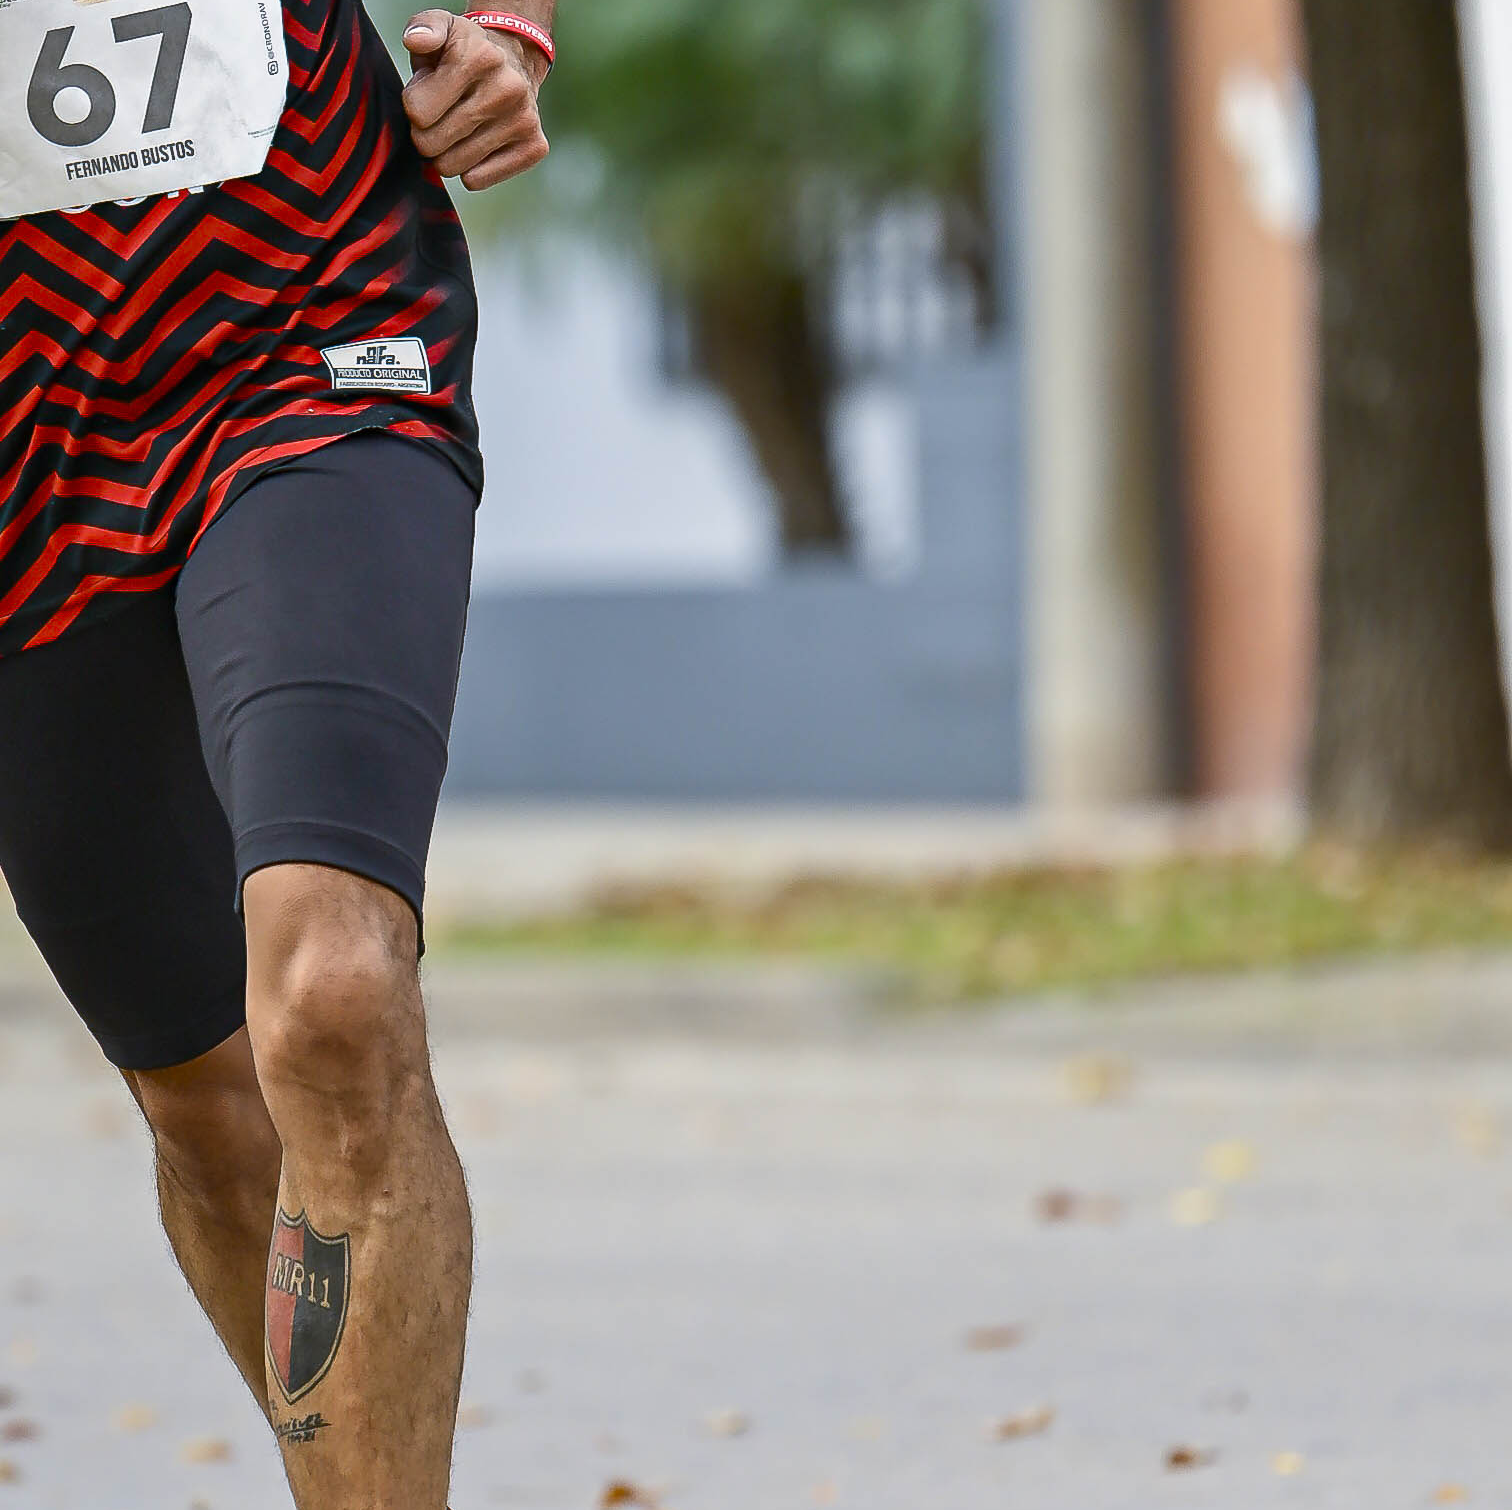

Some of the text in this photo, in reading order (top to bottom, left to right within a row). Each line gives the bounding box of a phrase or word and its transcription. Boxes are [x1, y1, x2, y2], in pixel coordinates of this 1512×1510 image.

[26, 2, 193, 147] 67
[66, 140, 195, 180] FERNANDO BUSTOS
[373, 368, 423, 380] ORIGINAL
